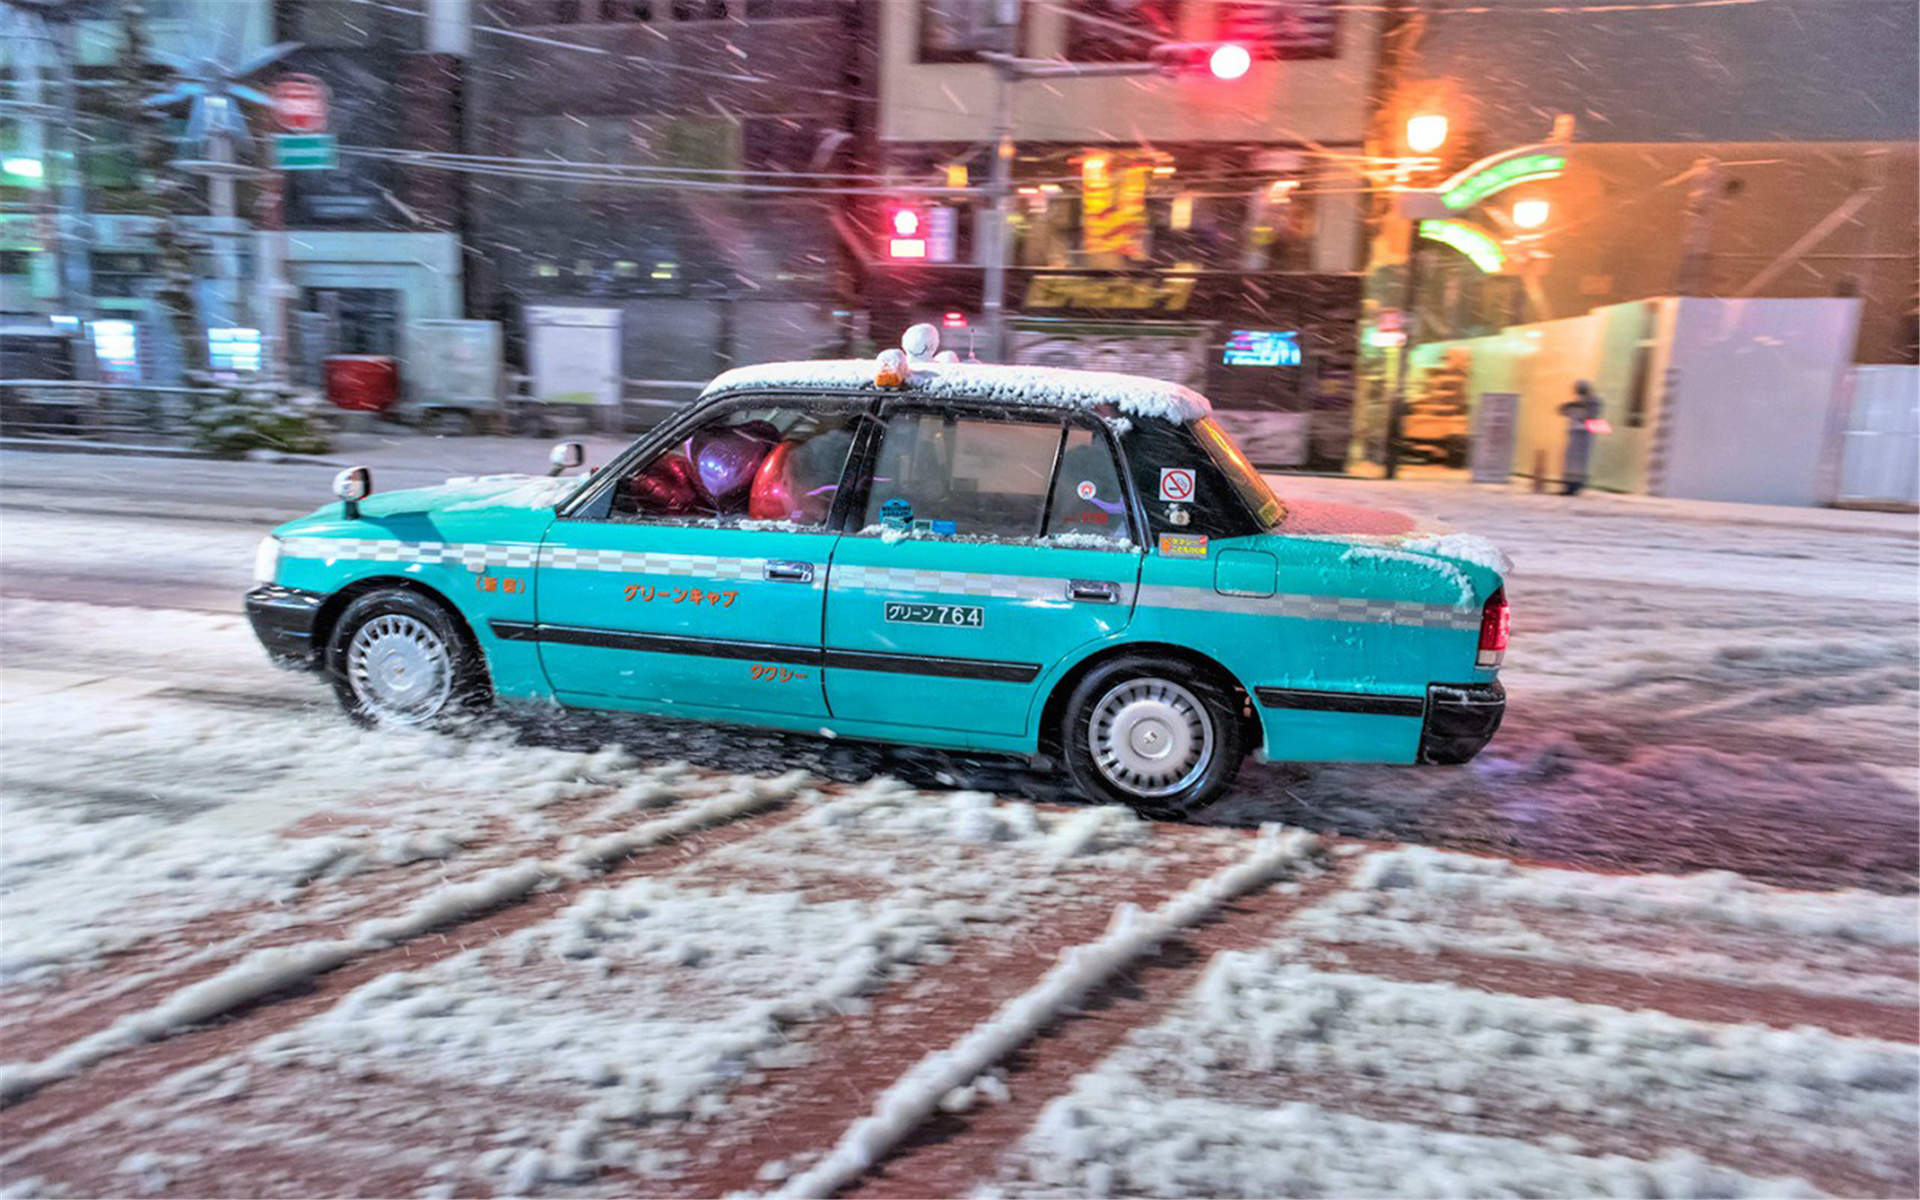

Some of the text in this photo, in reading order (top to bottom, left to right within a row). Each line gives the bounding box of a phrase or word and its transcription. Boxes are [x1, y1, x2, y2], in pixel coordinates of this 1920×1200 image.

[889, 606, 980, 626] グリーン 764
[750, 664, 808, 682] タクシー
